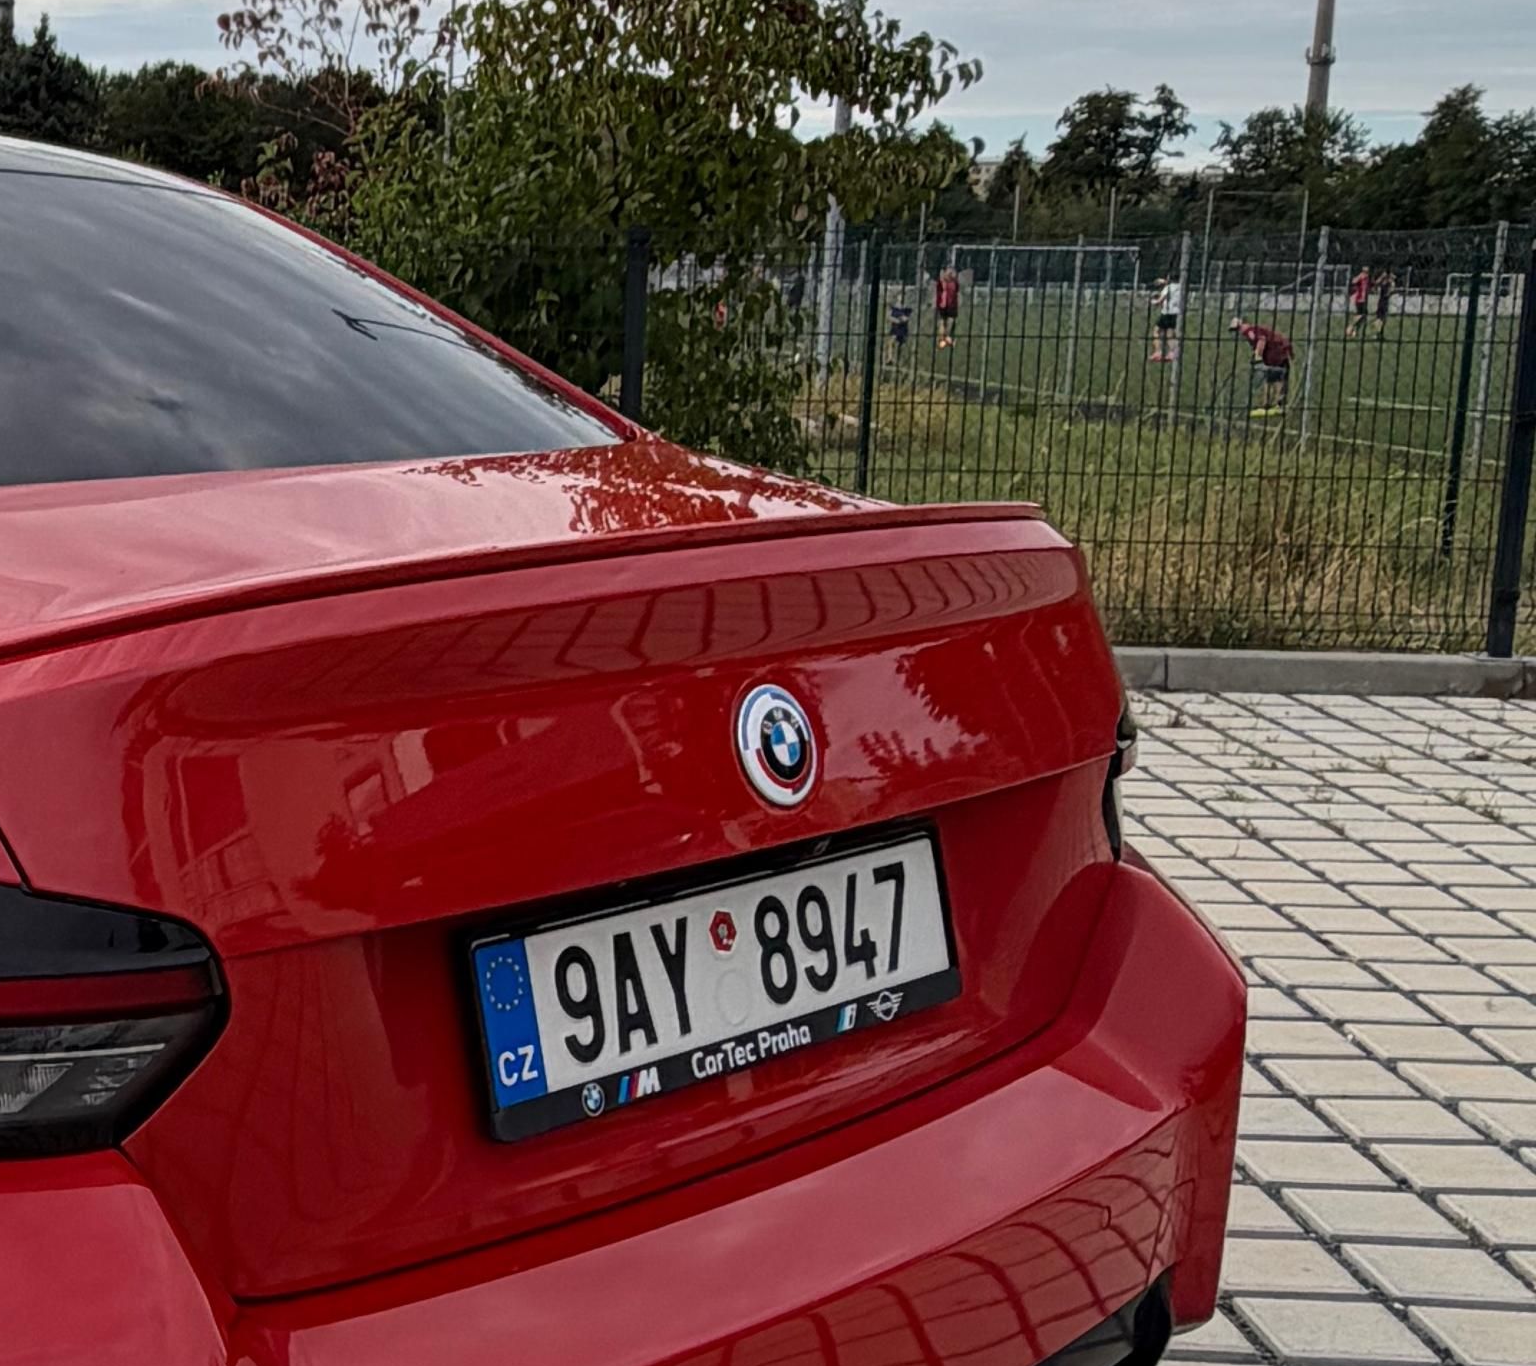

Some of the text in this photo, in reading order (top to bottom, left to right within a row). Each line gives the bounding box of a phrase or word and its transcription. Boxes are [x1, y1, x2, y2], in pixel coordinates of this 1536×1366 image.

[763, 708, 800, 734] BMW
[554, 861, 904, 1064] 9AY 8947
[498, 1044, 539, 1087] CZ
[691, 1023, 811, 1080] CarTec Praha
